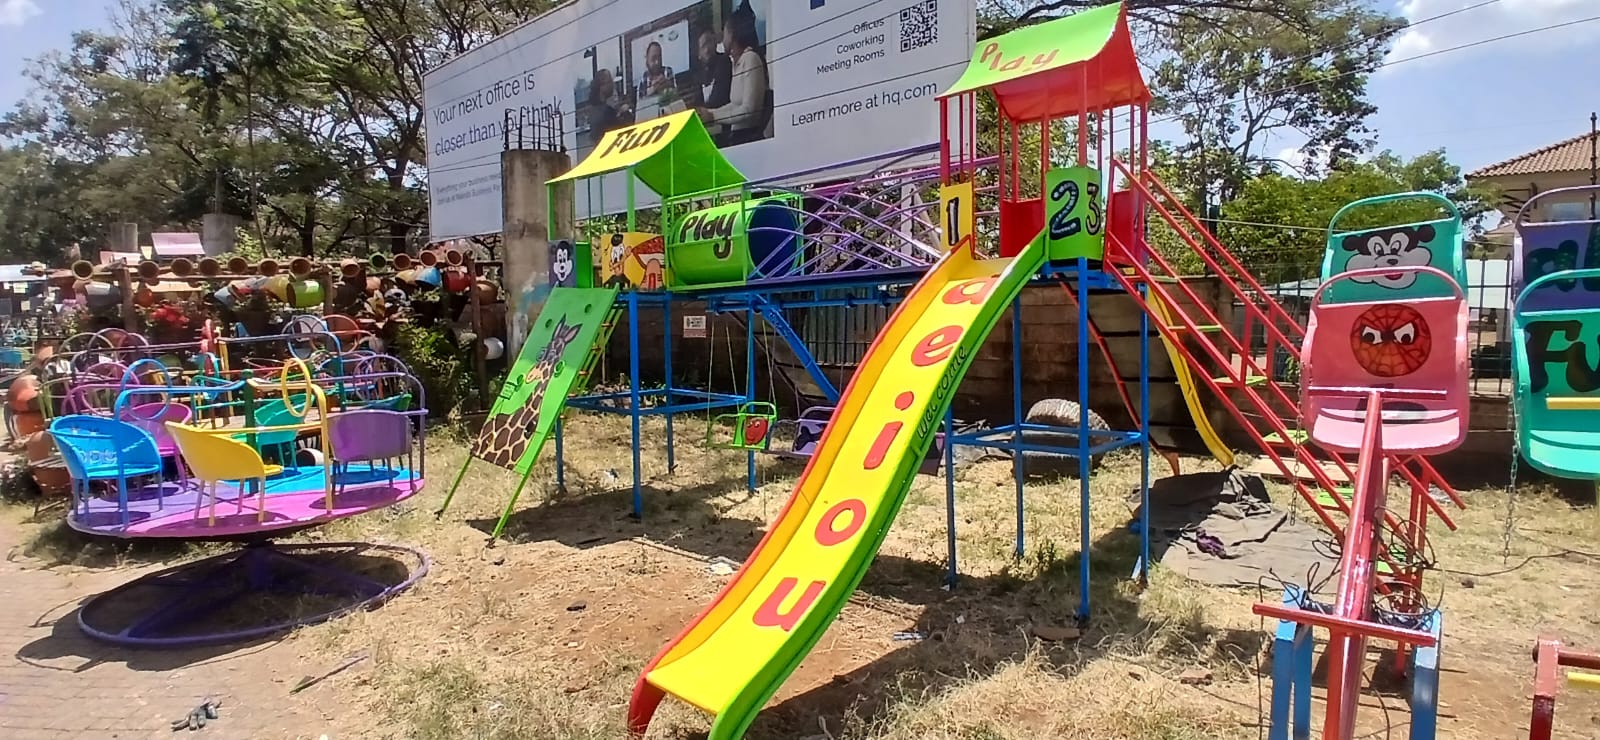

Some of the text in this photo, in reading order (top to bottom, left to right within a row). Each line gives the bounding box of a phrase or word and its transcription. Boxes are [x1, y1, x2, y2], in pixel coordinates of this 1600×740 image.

[836, 33, 885, 55] Coworking
[853, 18, 885, 34] Offices
[816, 48, 885, 75] Meeting Rooms
[979, 42, 1060, 72] Play
[433, 71, 536, 126] Your next office is
[791, 82, 938, 127] Learn more at hq.com
[435, 133, 470, 157] closer
[469, 122, 496, 145] than
[599, 122, 671, 159] Fun
[679, 210, 740, 260] Play
[946, 196, 960, 246] 1
[752, 276, 999, 632] a e i o u
